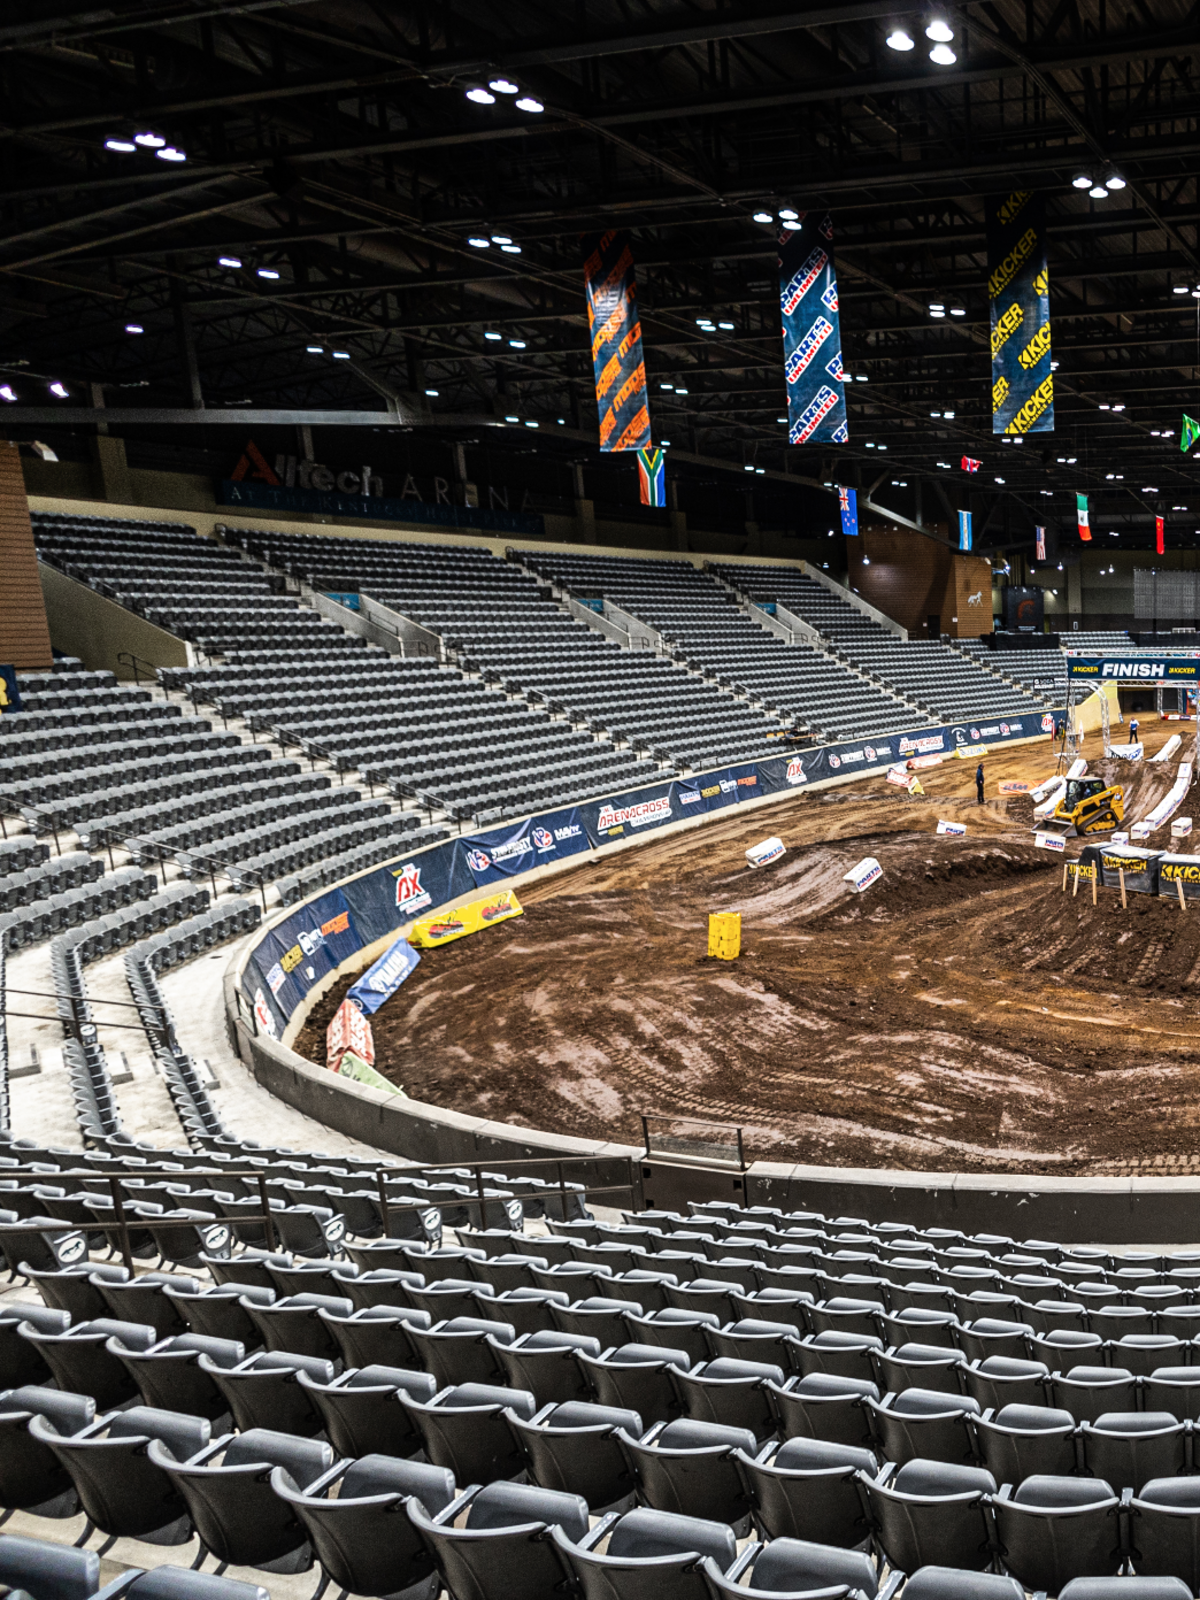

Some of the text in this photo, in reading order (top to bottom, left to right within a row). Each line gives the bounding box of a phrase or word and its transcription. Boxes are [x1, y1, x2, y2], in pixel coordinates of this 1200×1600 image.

[780, 246, 825, 309] PARTS
[993, 228, 1037, 290] KICKER
[784, 254, 828, 315] UNLIMITED
[785, 317, 826, 378] PARTS
[789, 324, 832, 383] UNLIMITED
[789, 387, 832, 443] PARTS
[231, 439, 539, 514] Alltech ARENA
[1102, 663, 1165, 677] FINISH
[787, 761, 804, 778] AX
[960, 744, 986, 756] SUZUKI
[599, 797, 670, 829] ARENACROSS
[758, 845, 783, 863] PARTS
[397, 871, 426, 903] AX
[857, 866, 880, 887] PARTS
